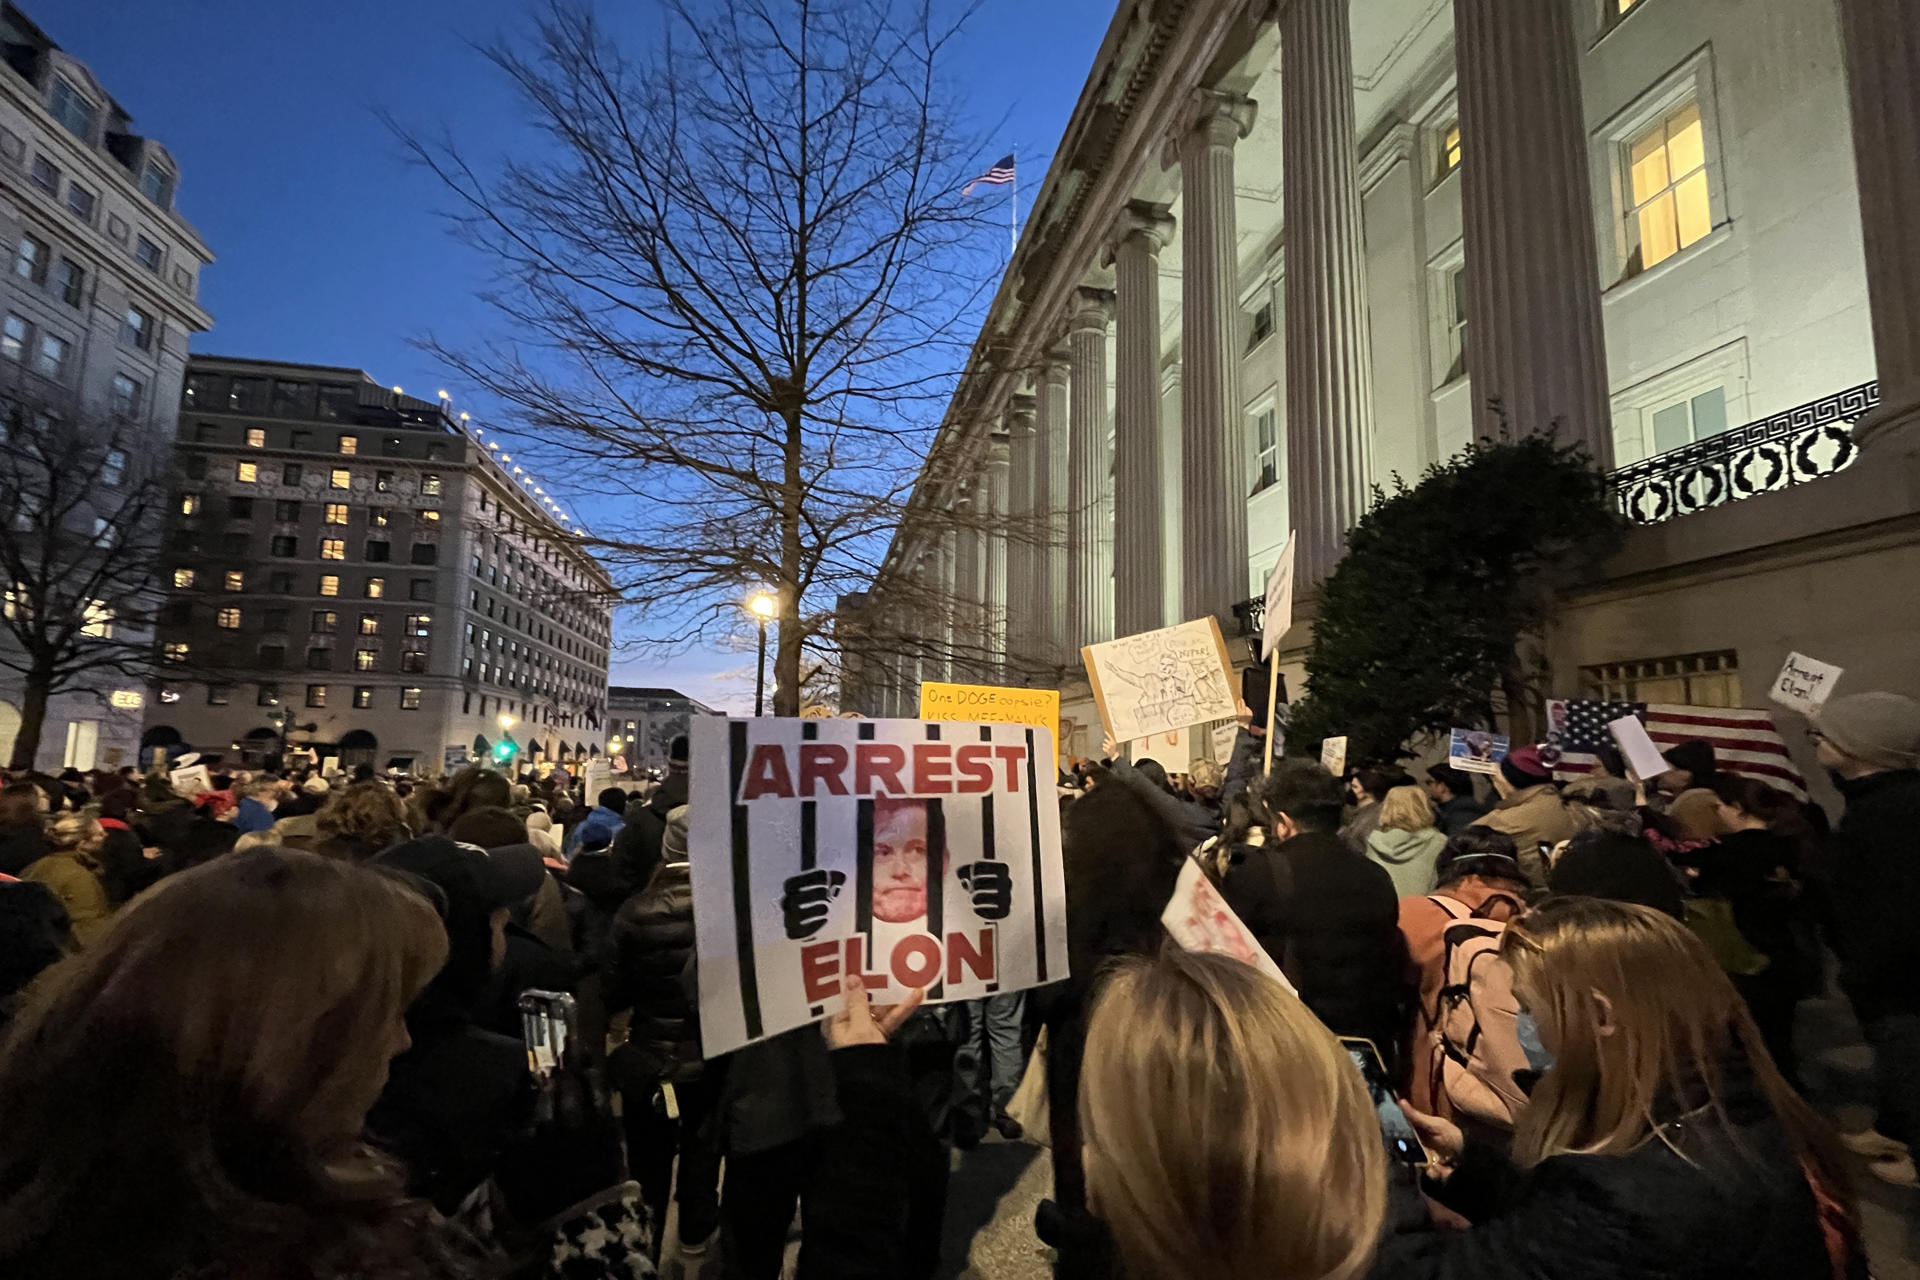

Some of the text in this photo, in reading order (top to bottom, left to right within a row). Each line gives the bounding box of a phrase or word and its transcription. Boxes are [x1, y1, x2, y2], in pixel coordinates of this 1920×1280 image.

[928, 688, 953, 703] One
[957, 690, 997, 705] DOGE
[742, 743, 1027, 801] ARREST
[800, 928, 996, 1004] ELON
